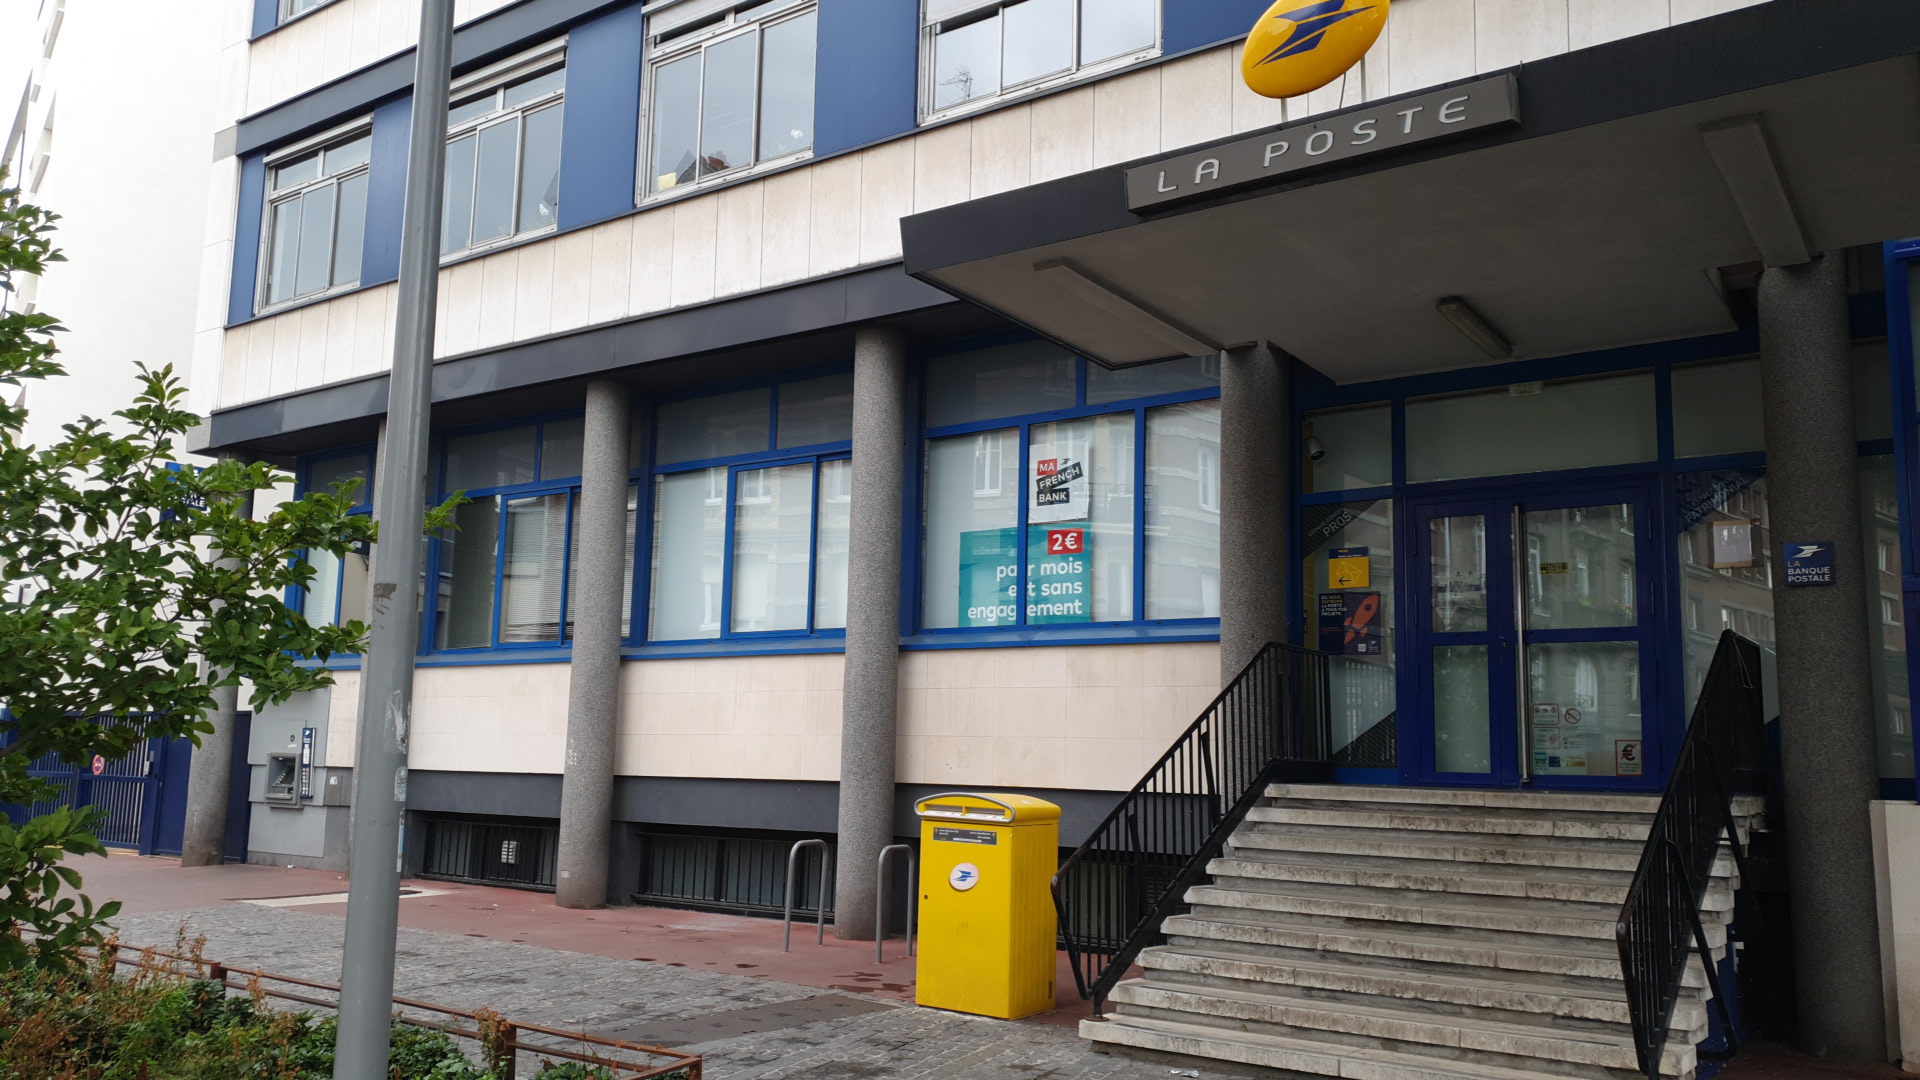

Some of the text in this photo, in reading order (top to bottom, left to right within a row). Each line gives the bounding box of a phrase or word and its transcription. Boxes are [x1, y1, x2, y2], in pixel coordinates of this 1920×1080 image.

[1157, 94, 1470, 193] LA POSTE
[1039, 462, 1055, 473] MA
[1039, 465, 1080, 490] FRENCH
[1039, 491, 1067, 503] BANK
[1322, 511, 1352, 537] PROS
[1052, 532, 1078, 551] 2€
[1040, 556, 1083, 576] mois
[1788, 566, 1831, 575] BANQUE
[1788, 574, 1831, 582] POSTALE
[1008, 581, 1083, 597] et sans
[967, 599, 1083, 622] engagement
